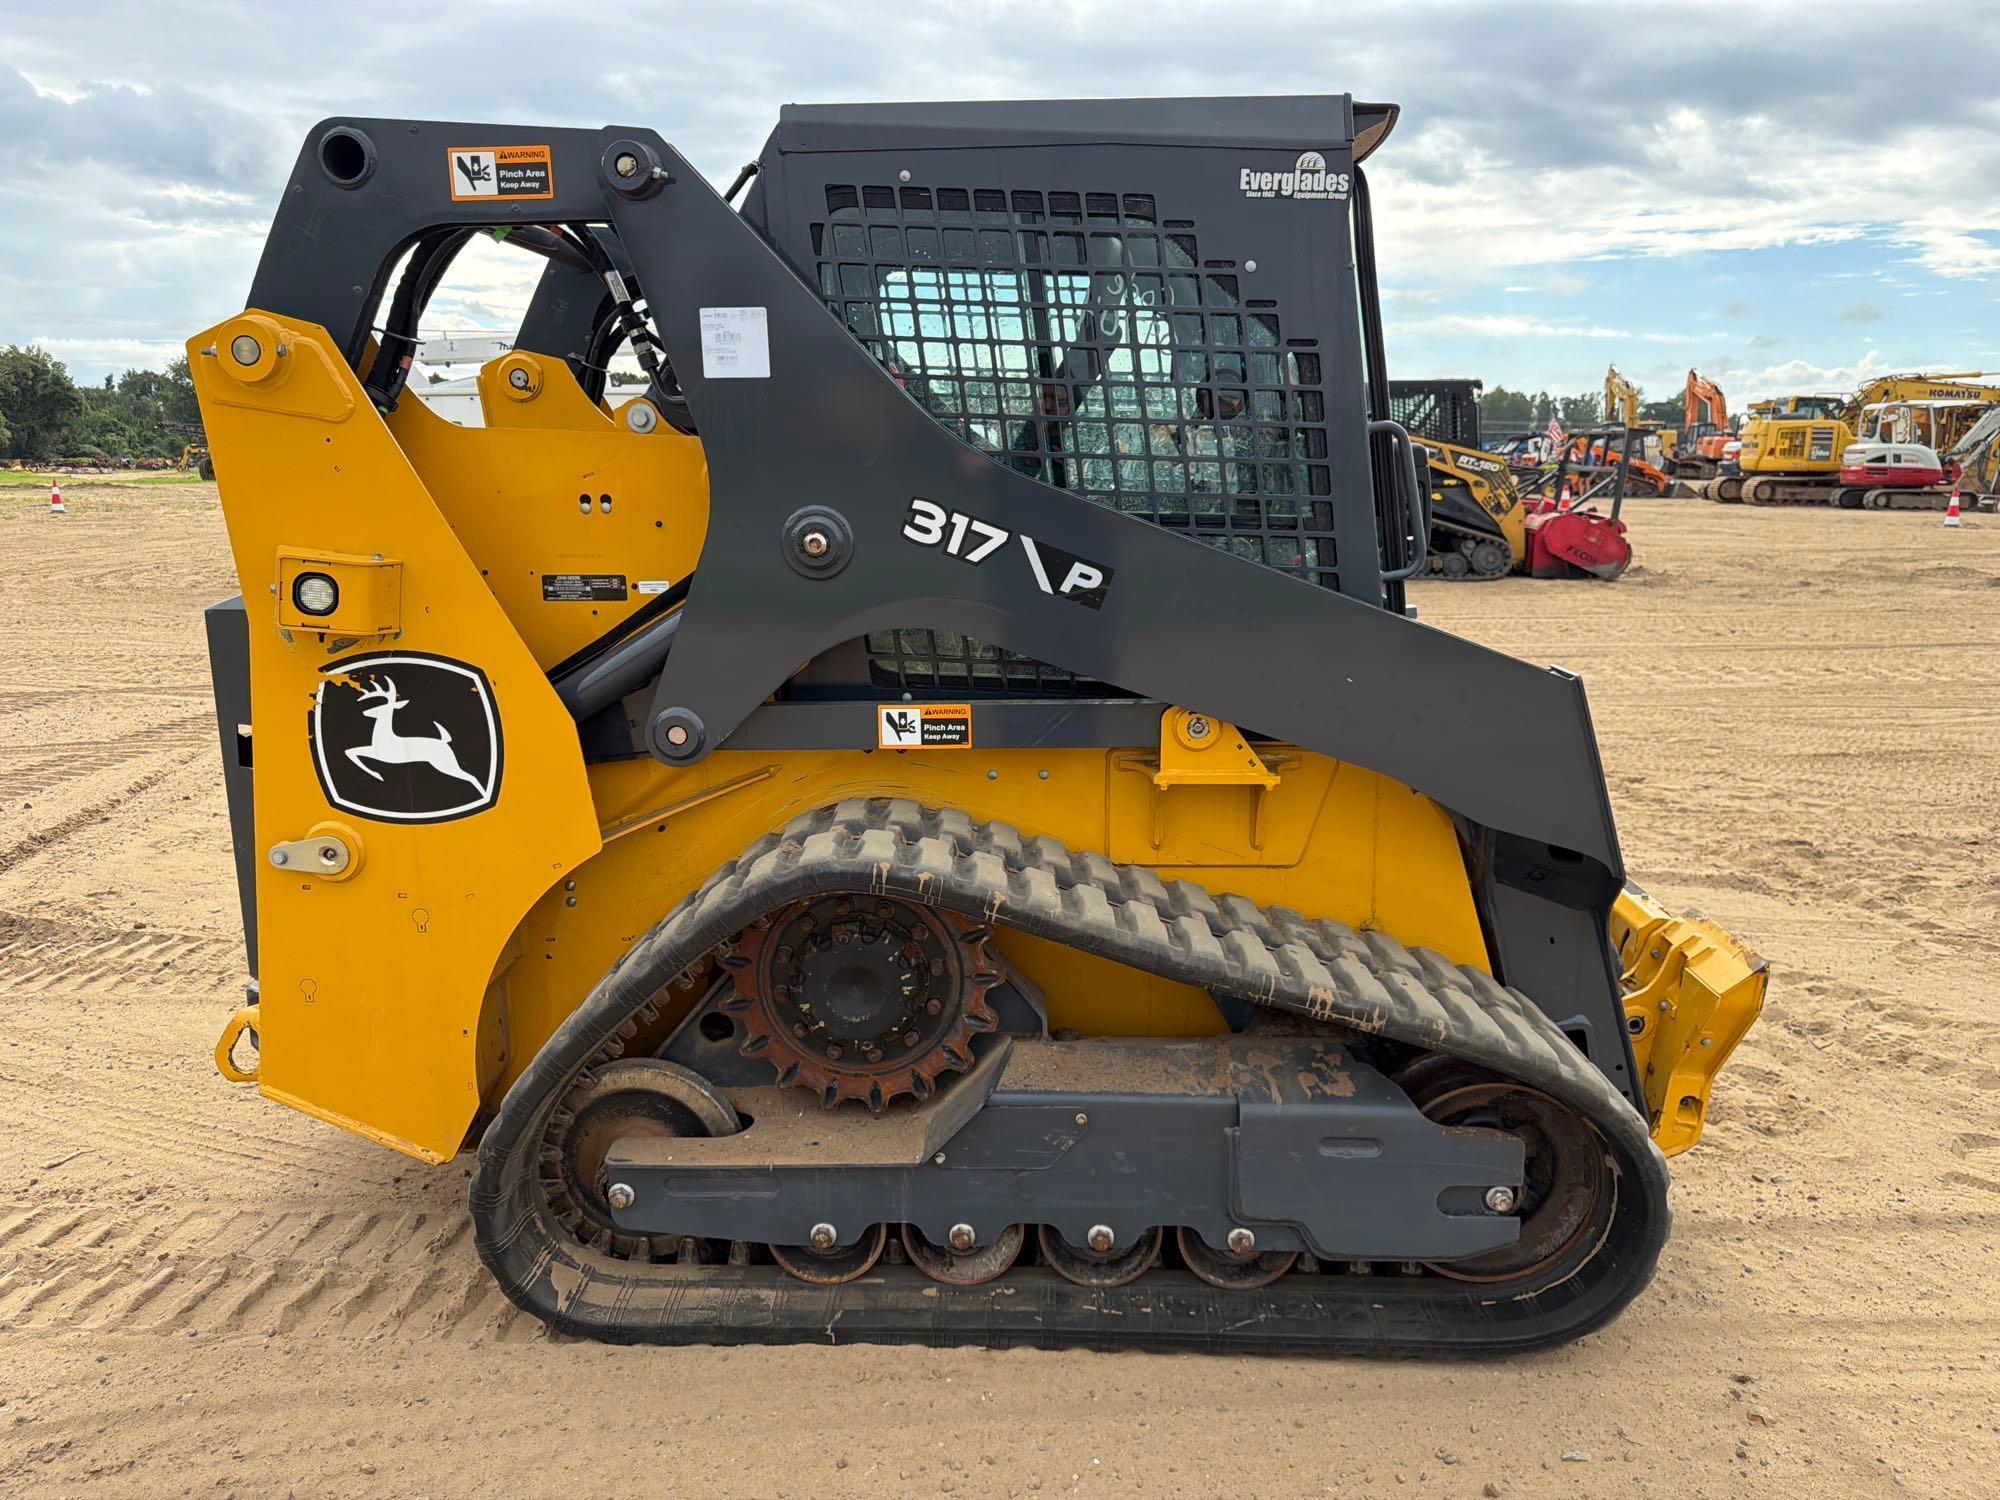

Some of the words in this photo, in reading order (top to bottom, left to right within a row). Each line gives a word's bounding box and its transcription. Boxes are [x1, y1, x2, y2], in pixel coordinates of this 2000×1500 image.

[507, 150, 546, 160] WARNING
[500, 169, 524, 178] Pinch
[526, 169, 545, 177] Area
[500, 181, 519, 190] Keep
[521, 181, 540, 190] Away
[1239, 168, 1350, 196] Everglades
[1293, 191, 1328, 200] Equipment
[1328, 192, 1348, 201] Group
[1929, 388, 1981, 399] KOMATSU
[1457, 454, 1500, 472] RT-120
[902, 498, 1010, 563] 317
[1566, 544, 1600, 565] FECON
[931, 708, 967, 716] WARNING
[924, 723, 946, 731] Pinch
[947, 723, 965, 731] Area
[924, 733, 942, 741] Keep
[942, 733, 960, 741] Away
